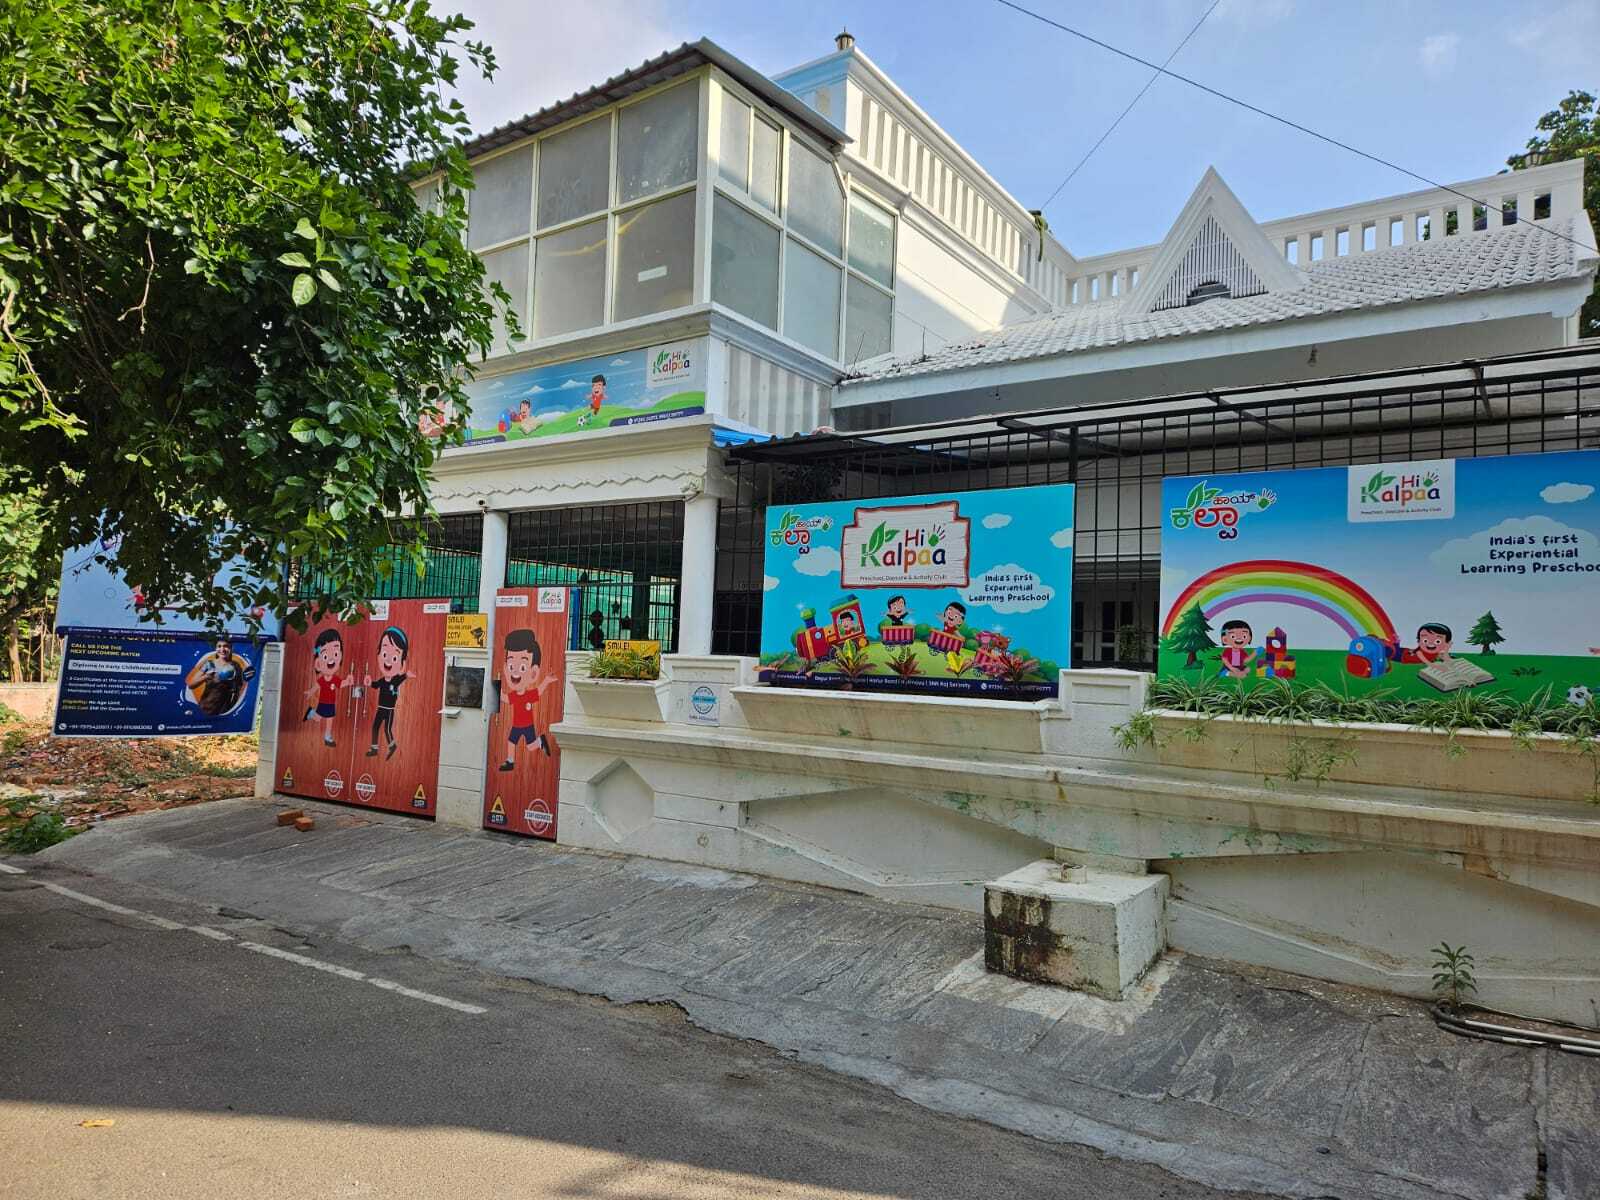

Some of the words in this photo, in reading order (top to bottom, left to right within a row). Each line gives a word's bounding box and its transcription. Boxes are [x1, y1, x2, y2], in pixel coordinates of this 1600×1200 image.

[672, 351, 682, 361] Hi
[652, 358, 690, 375] Kalpaa
[1401, 474, 1420, 488] Hi
[1360, 485, 1441, 506] Kalpaa
[905, 528, 925, 548] Hi
[1489, 535, 1536, 546] India's
[1542, 534, 1579, 546] first
[860, 540, 947, 574] Kalpaa
[1489, 548, 1579, 562] Experiential
[1461, 563, 1527, 575] Learning
[1013, 573, 1033, 583] first
[984, 583, 1033, 594] Experiential
[968, 594, 1005, 603] Learning
[1007, 593, 1050, 602] Preschool
[607, 641, 630, 650] SMILE!
